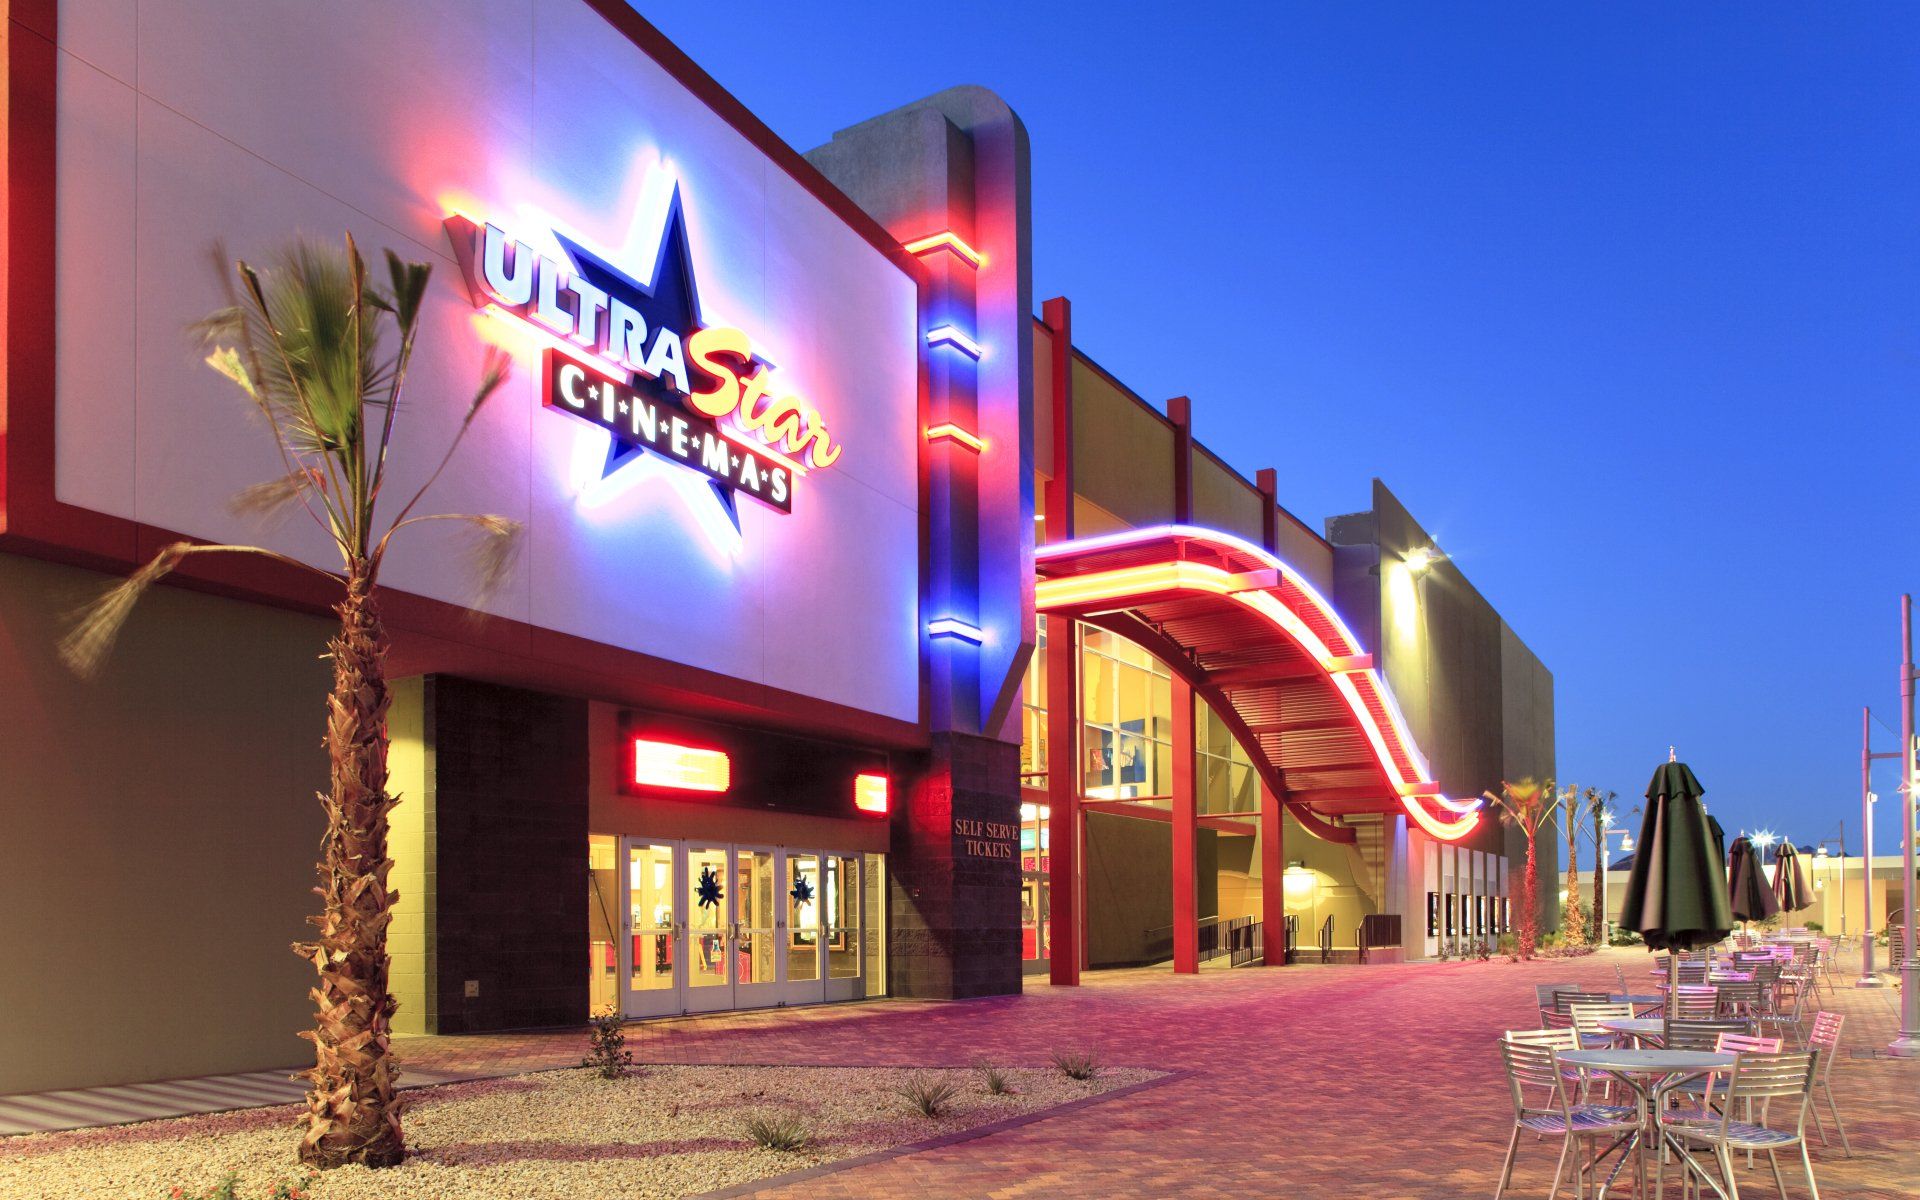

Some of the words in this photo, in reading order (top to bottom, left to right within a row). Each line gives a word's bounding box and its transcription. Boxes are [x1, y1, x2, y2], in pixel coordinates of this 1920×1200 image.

[484, 221, 691, 395] ULTRA
[687, 327, 843, 468] Star
[559, 364, 788, 503] CINEMAS
[955, 818, 983, 837] SELF
[986, 822, 1019, 841] SERVE
[966, 839, 1011, 859] TICKETS
